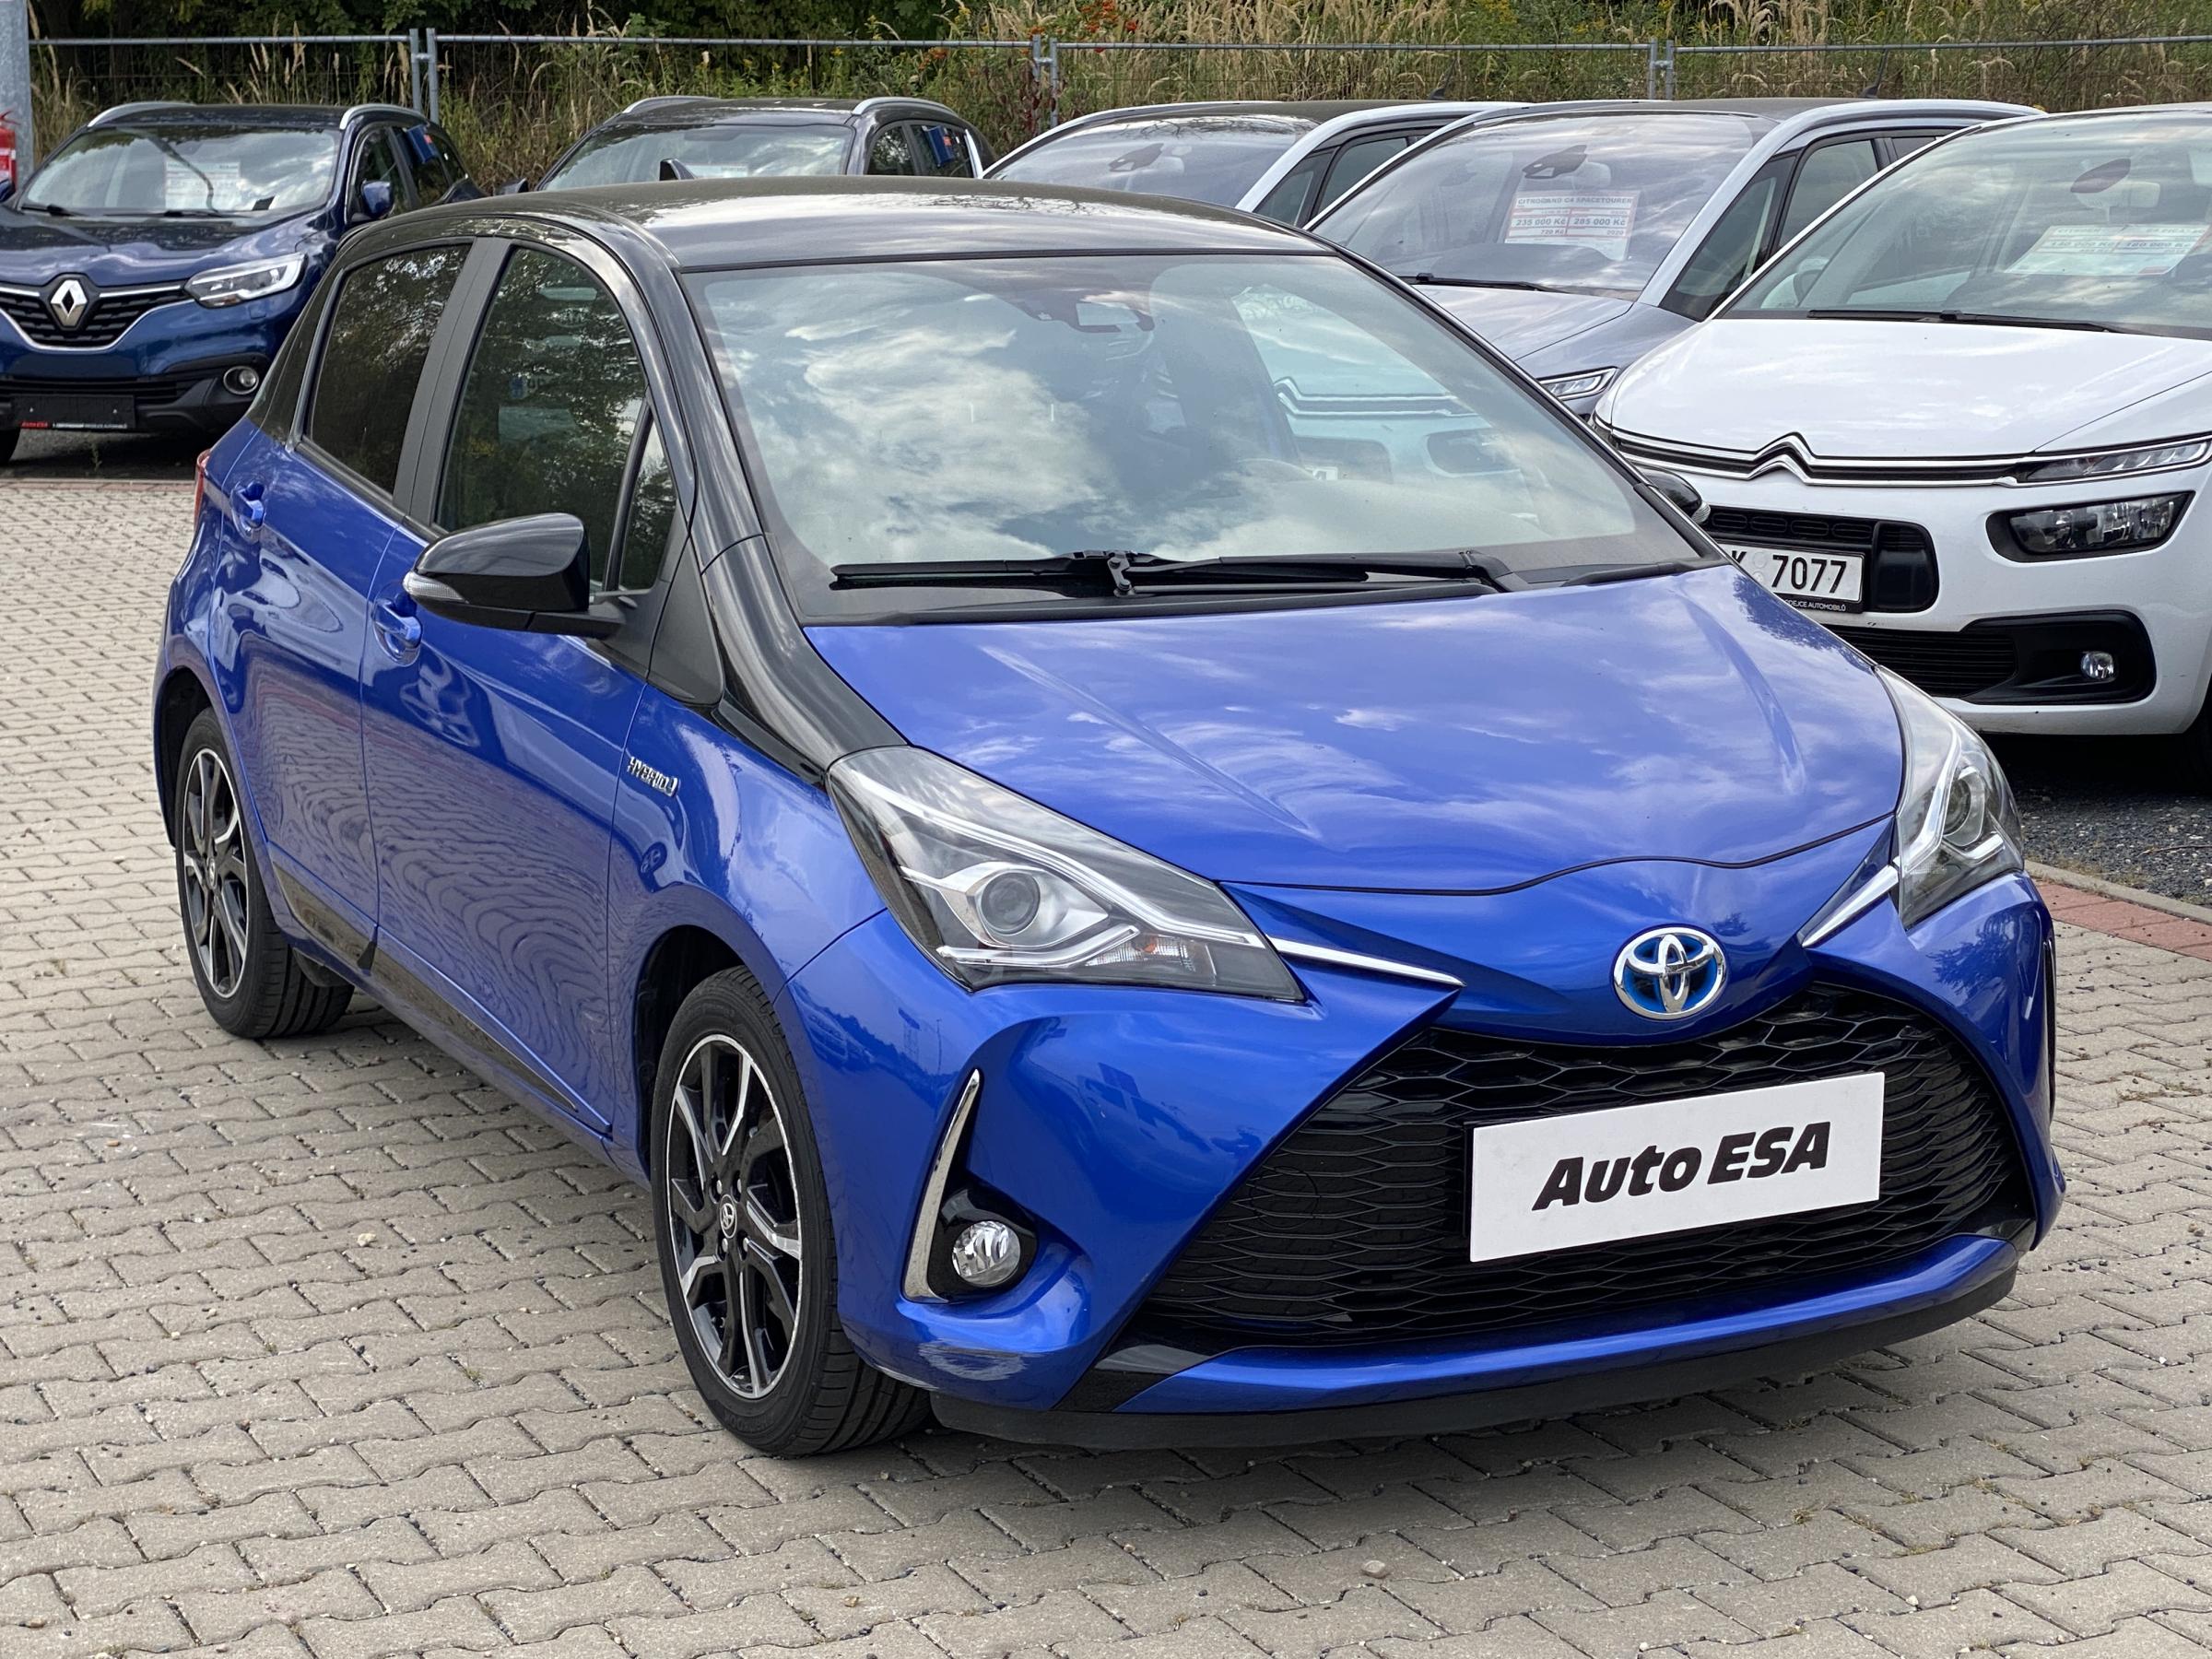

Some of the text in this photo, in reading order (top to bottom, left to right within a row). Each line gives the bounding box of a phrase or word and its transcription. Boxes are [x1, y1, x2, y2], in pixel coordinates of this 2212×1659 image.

[1594, 218, 1611, 226] 000
[1771, 554, 1847, 594] 7077
[1531, 1121, 1831, 1212] Auto ESA
